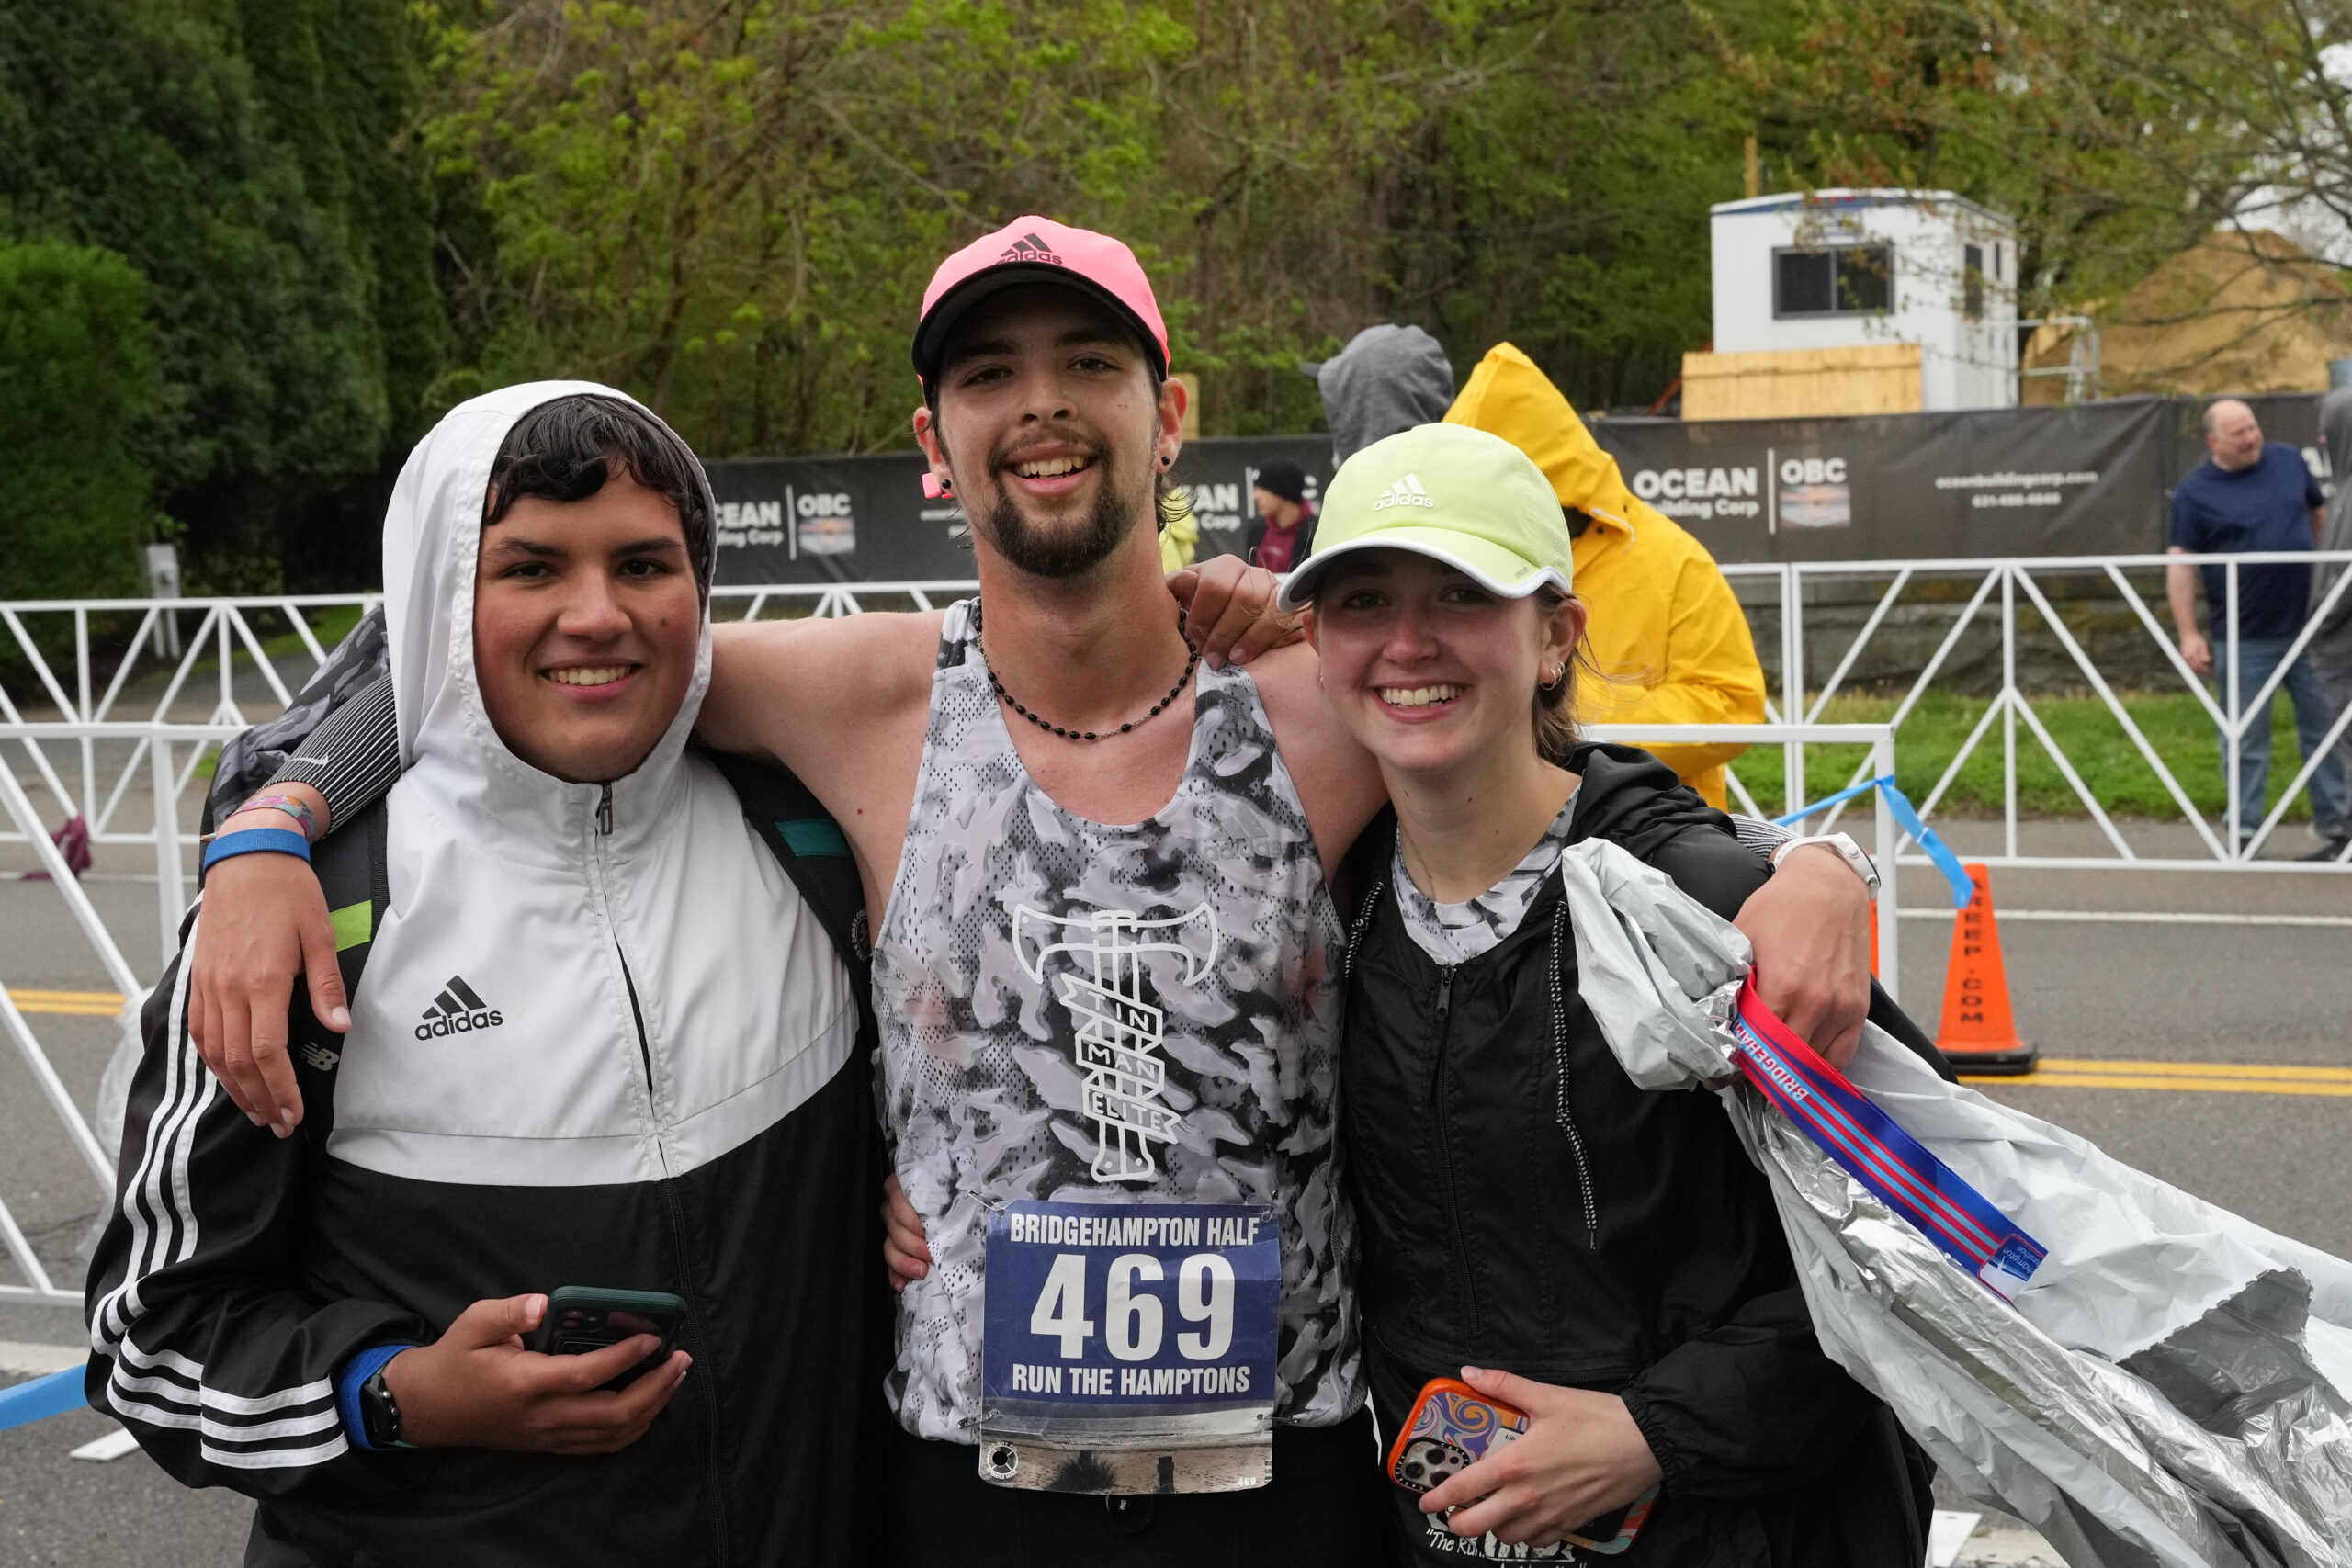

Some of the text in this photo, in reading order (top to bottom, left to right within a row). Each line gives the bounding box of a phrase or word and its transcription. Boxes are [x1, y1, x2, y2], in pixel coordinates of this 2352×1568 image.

[1633, 467, 1758, 500] OCEAN
[1781, 457, 1847, 485] OBC
[717, 501, 782, 529] EAN
[797, 493, 851, 518] OBC
[1374, 491, 1434, 512] adidas
[1714, 498, 1760, 519] Corp
[748, 528, 784, 547] Corp
[1200, 512, 1242, 533] Corp
[414, 1008, 503, 1041] adidas
[1087, 991, 1149, 1032] TIN
[1088, 1044, 1156, 1079] MAN
[1733, 1020, 1810, 1102] BRIDGEHAM
[1092, 1092, 1162, 1131] ELITE
[1011, 1213, 1260, 1247] BRIDGEHAMPTON HALF
[1030, 1253, 1235, 1361] 469
[1012, 1363, 1250, 1395] RUN THE HAMPTONS
[1238, 1476, 1257, 1487] 469
[1425, 1527, 1455, 1551] "The
